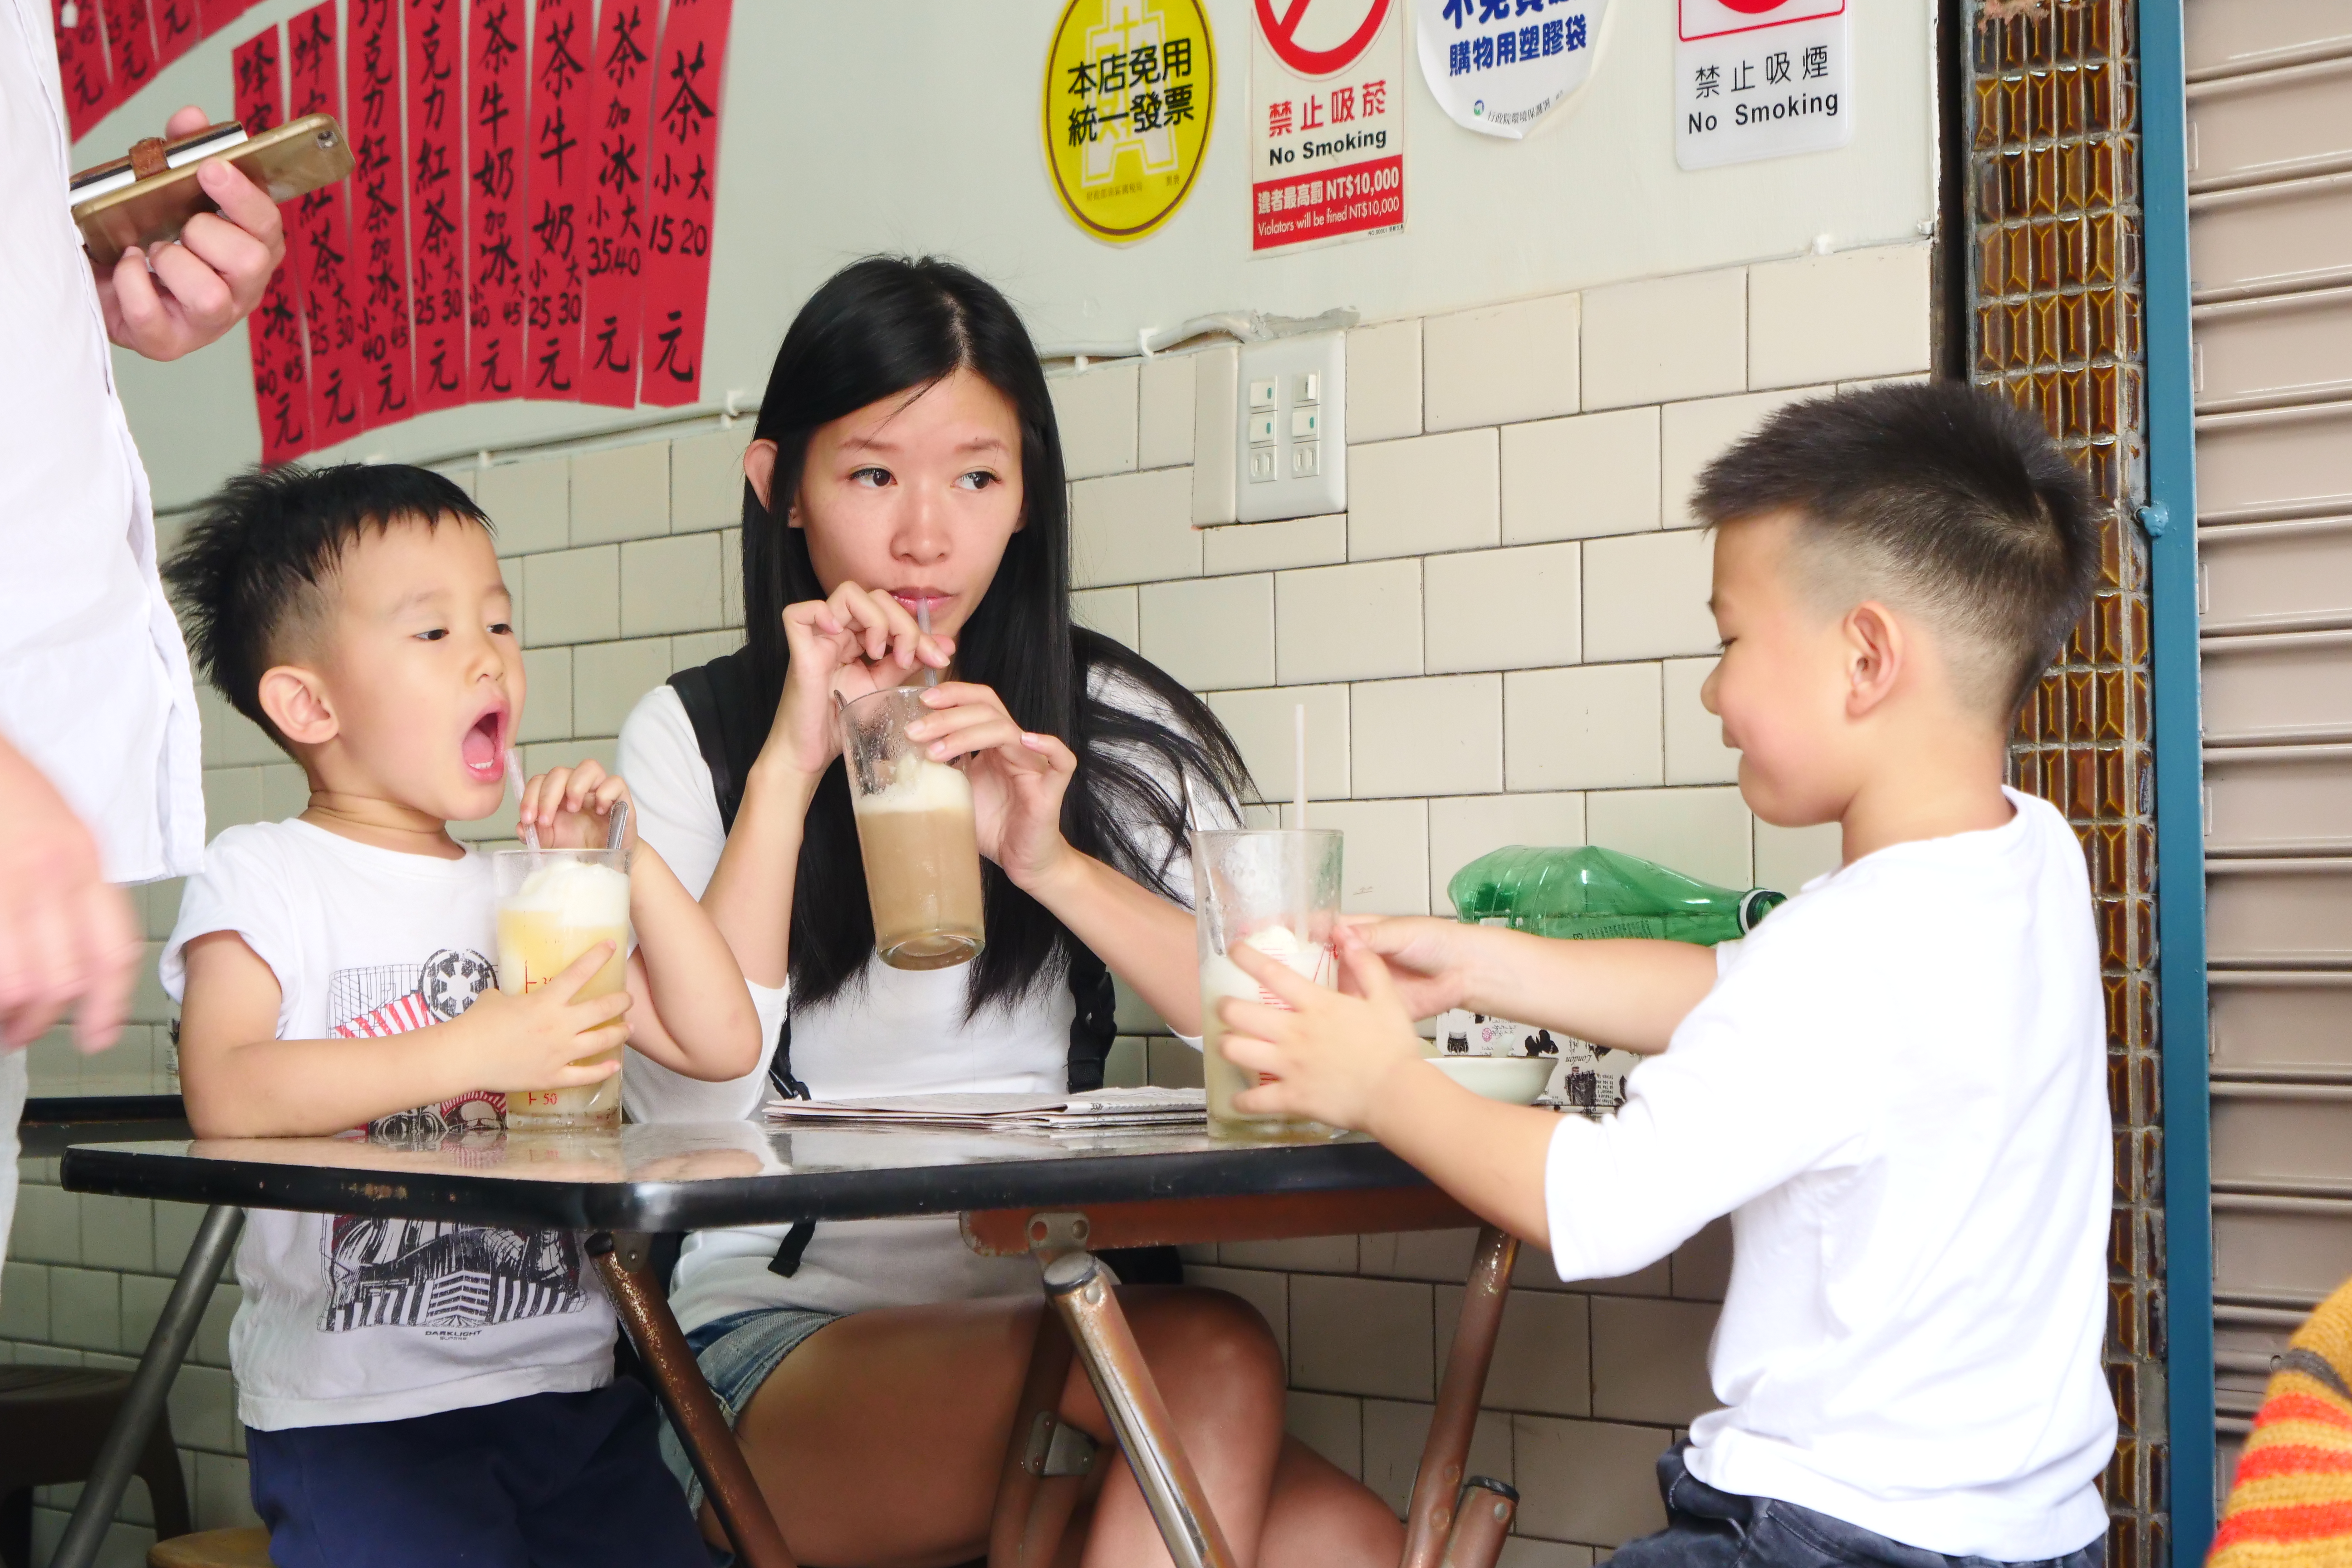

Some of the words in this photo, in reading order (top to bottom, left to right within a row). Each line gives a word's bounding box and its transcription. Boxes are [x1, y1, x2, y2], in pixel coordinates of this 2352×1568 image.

[1450, 14, 1587, 77] 購物用塑膠袋
[1068, 38, 1191, 99] 本店免用
[1695, 45, 1829, 99] 禁止吸煙
[1068, 83, 1194, 147] 統一發票
[1269, 80, 1387, 138] 禁止吸菸
[1689, 112, 1718, 134] No
[1735, 93, 1838, 126] Smoking
[1270, 148, 1295, 166] No
[1303, 130, 1387, 160] Smoking
[1258, 180, 1323, 215] 違者最高罰
[1326, 167, 1399, 200] NT$10,000
[649, 214, 675, 254] 15
[681, 218, 708, 257] 20
[1258, 220, 1294, 236] Violators
[1296, 213, 1311, 229] will
[1314, 211, 1325, 227] be
[1327, 205, 1347, 224] fined
[1348, 196, 1399, 220] NT$10,000
[588, 237, 613, 277] 35
[614, 247, 641, 275] 40
[415, 296, 435, 325] 25
[441, 289, 461, 322] 30
[529, 295, 552, 330] 25
[559, 292, 581, 325] 30
[1565, 1055, 1592, 1066] London
[543, 1093, 559, 1105] 50
